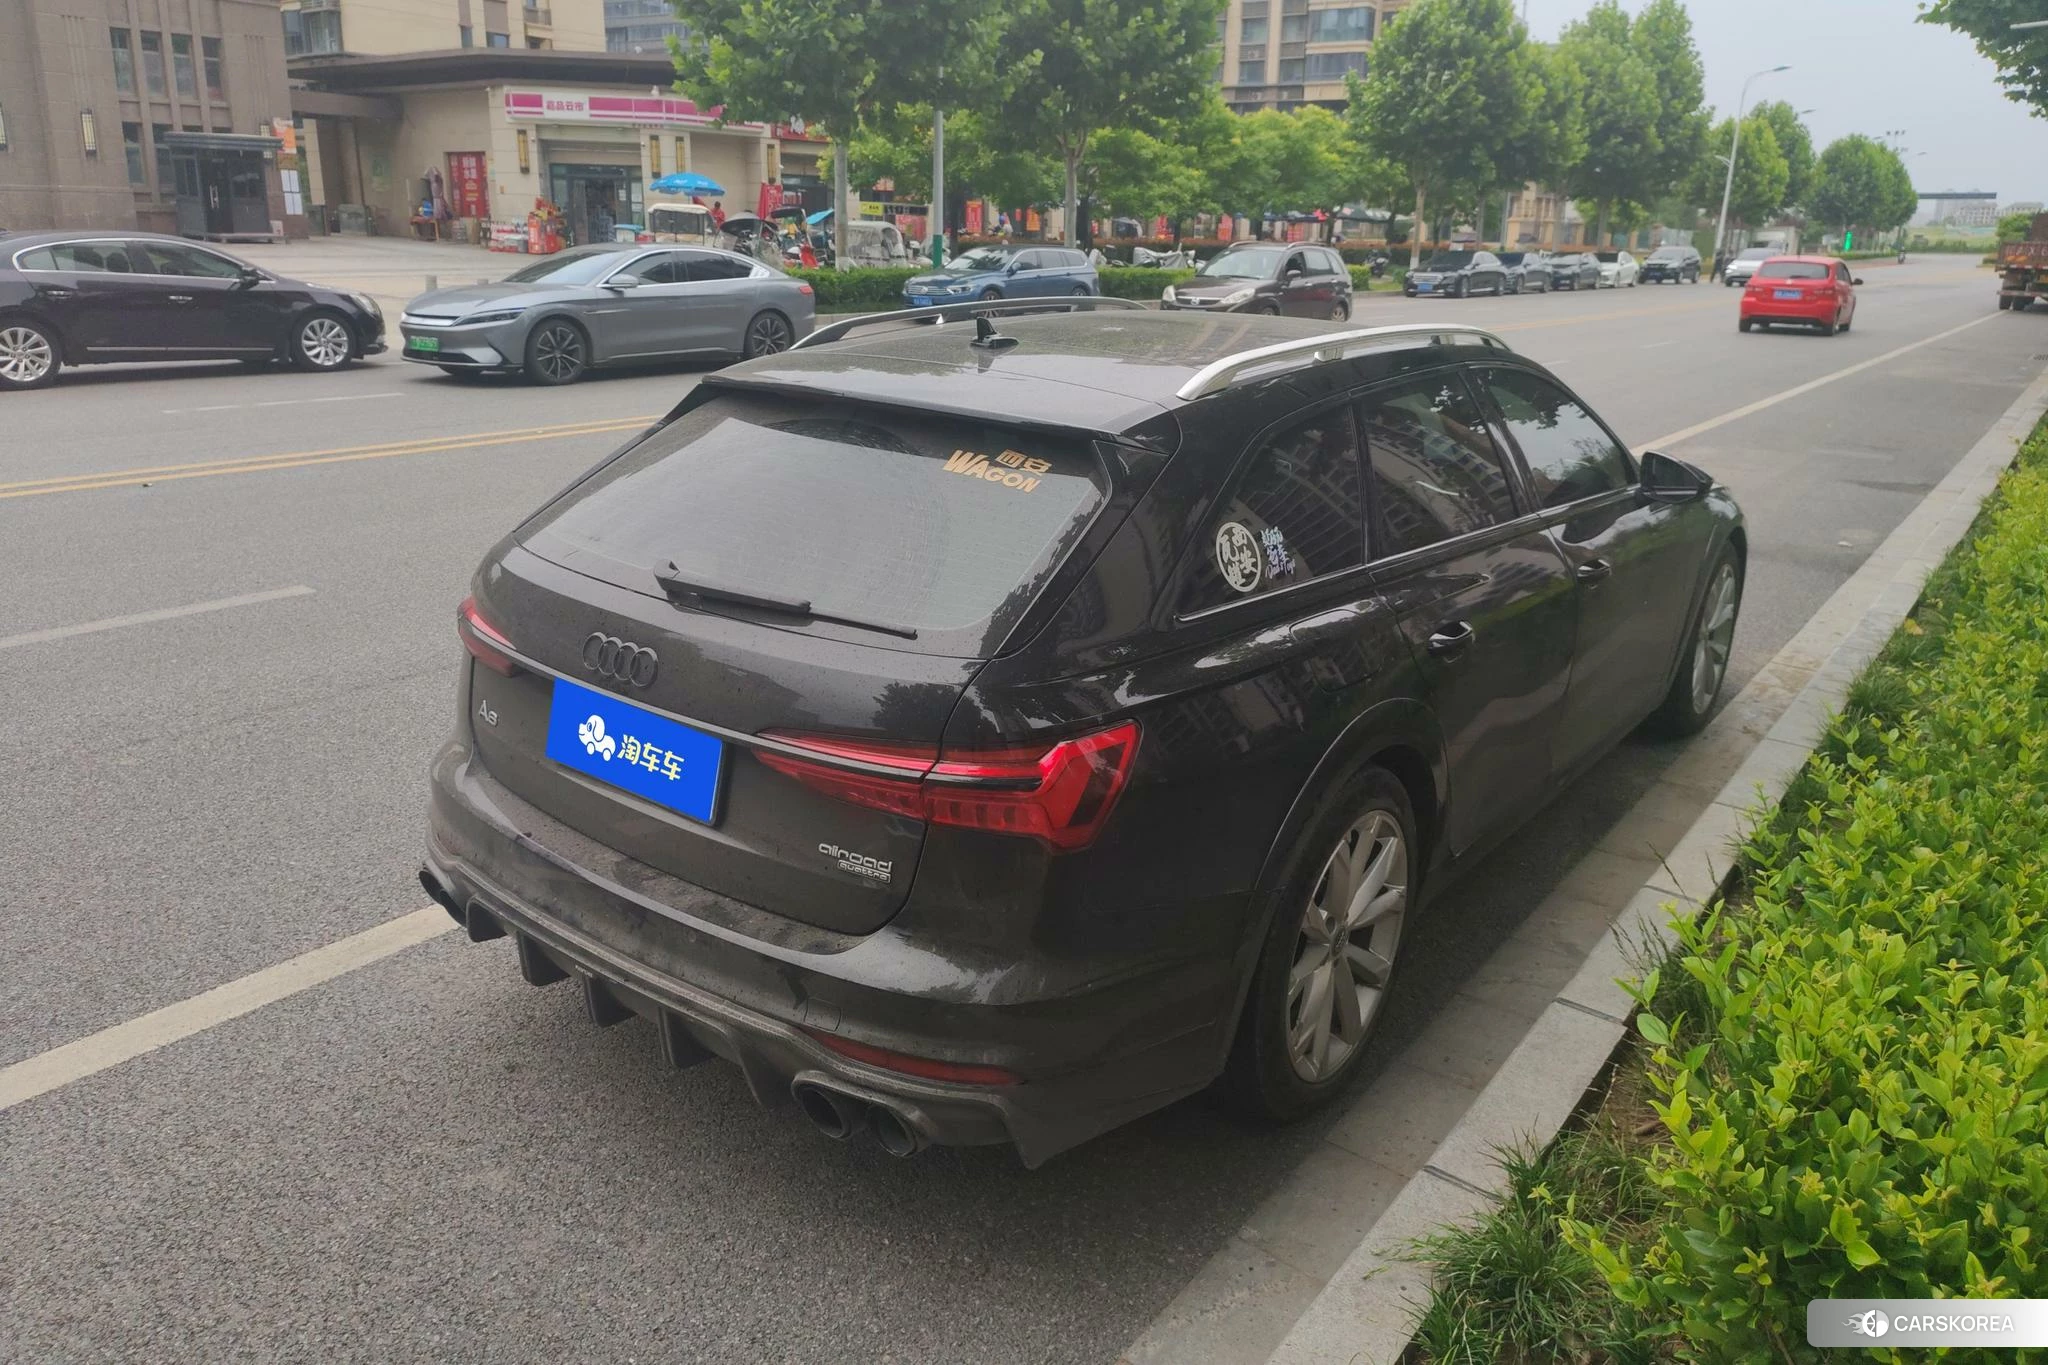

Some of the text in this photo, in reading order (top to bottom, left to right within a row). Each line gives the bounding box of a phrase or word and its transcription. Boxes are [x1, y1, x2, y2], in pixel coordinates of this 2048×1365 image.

[942, 449, 1042, 494] WAGON
[818, 842, 893, 873] allroad
[839, 861, 889, 882] quattro
